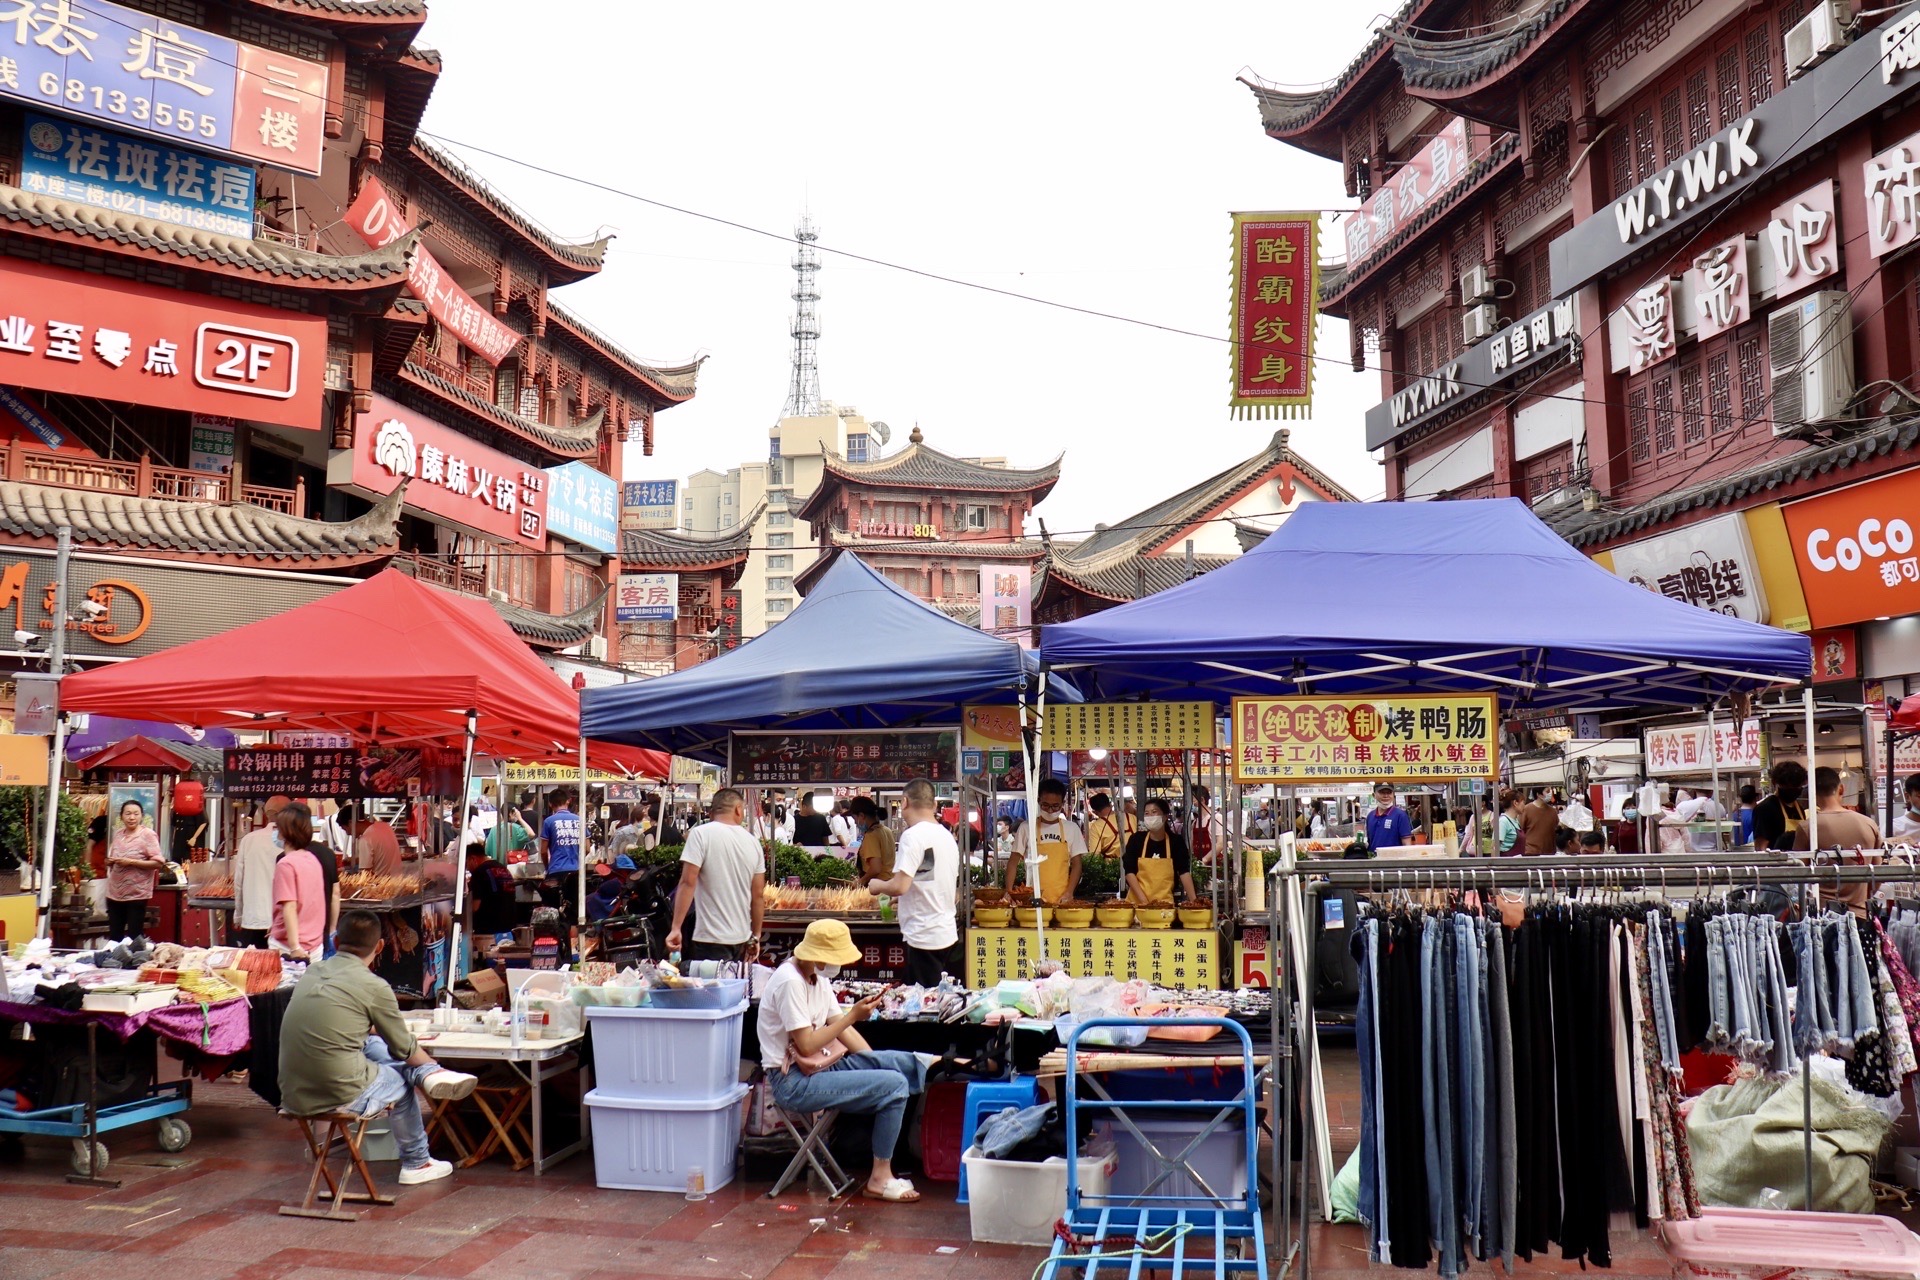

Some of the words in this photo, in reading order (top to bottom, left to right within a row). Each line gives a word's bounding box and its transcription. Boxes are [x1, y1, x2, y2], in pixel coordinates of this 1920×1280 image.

[0, 0, 214, 97] 祛痘
[39, 71, 217, 138] 68133555
[259, 64, 301, 154] 三楼
[64, 126, 251, 212] 祛斑祛痘
[1615, 117, 1761, 244] W.Y.W.K
[1346, 137, 1454, 258] 酷霸纹身
[1250, 235, 1297, 384] 酷霸纹身
[0, 315, 180, 377] 业至零点
[214, 338, 276, 381] 2F
[1390, 363, 1463, 427] W.Y.W.K
[1490, 298, 1575, 373] 网鱼网咖
[419, 443, 517, 515] 傣妹火锅
[524, 514, 539, 532] 2F
[1806, 517, 1914, 572] CoCo
[624, 576, 666, 586] 小上海
[1879, 556, 1920, 589] 都可
[620, 585, 670, 607] 客房
[1265, 704, 1486, 741] 绝味秘制烤鸭肠
[238, 752, 305, 772] 冷锅串串
[505, 767, 557, 780] 秘制烤鸭肠
[560, 767, 603, 780] 10元0串
[1243, 744, 1372, 764] 纯手工小肉串
[1379, 743, 1489, 763] 铁板小鱿鱼
[1243, 765, 1294, 776] 传统手艺
[1304, 765, 1395, 776] 烤鸭肠10元30串
[1406, 765, 1489, 775] 小肉串5元30串
[251, 784, 265, 793] 152
[266, 784, 285, 793] 2128
[287, 784, 306, 793] 1648
[864, 946, 905, 966] 串串
[976, 936, 986, 989] 脆藕千张卷
[1017, 936, 1027, 978] 香辣鸭肠
[1242, 952, 1268, 988] 5
